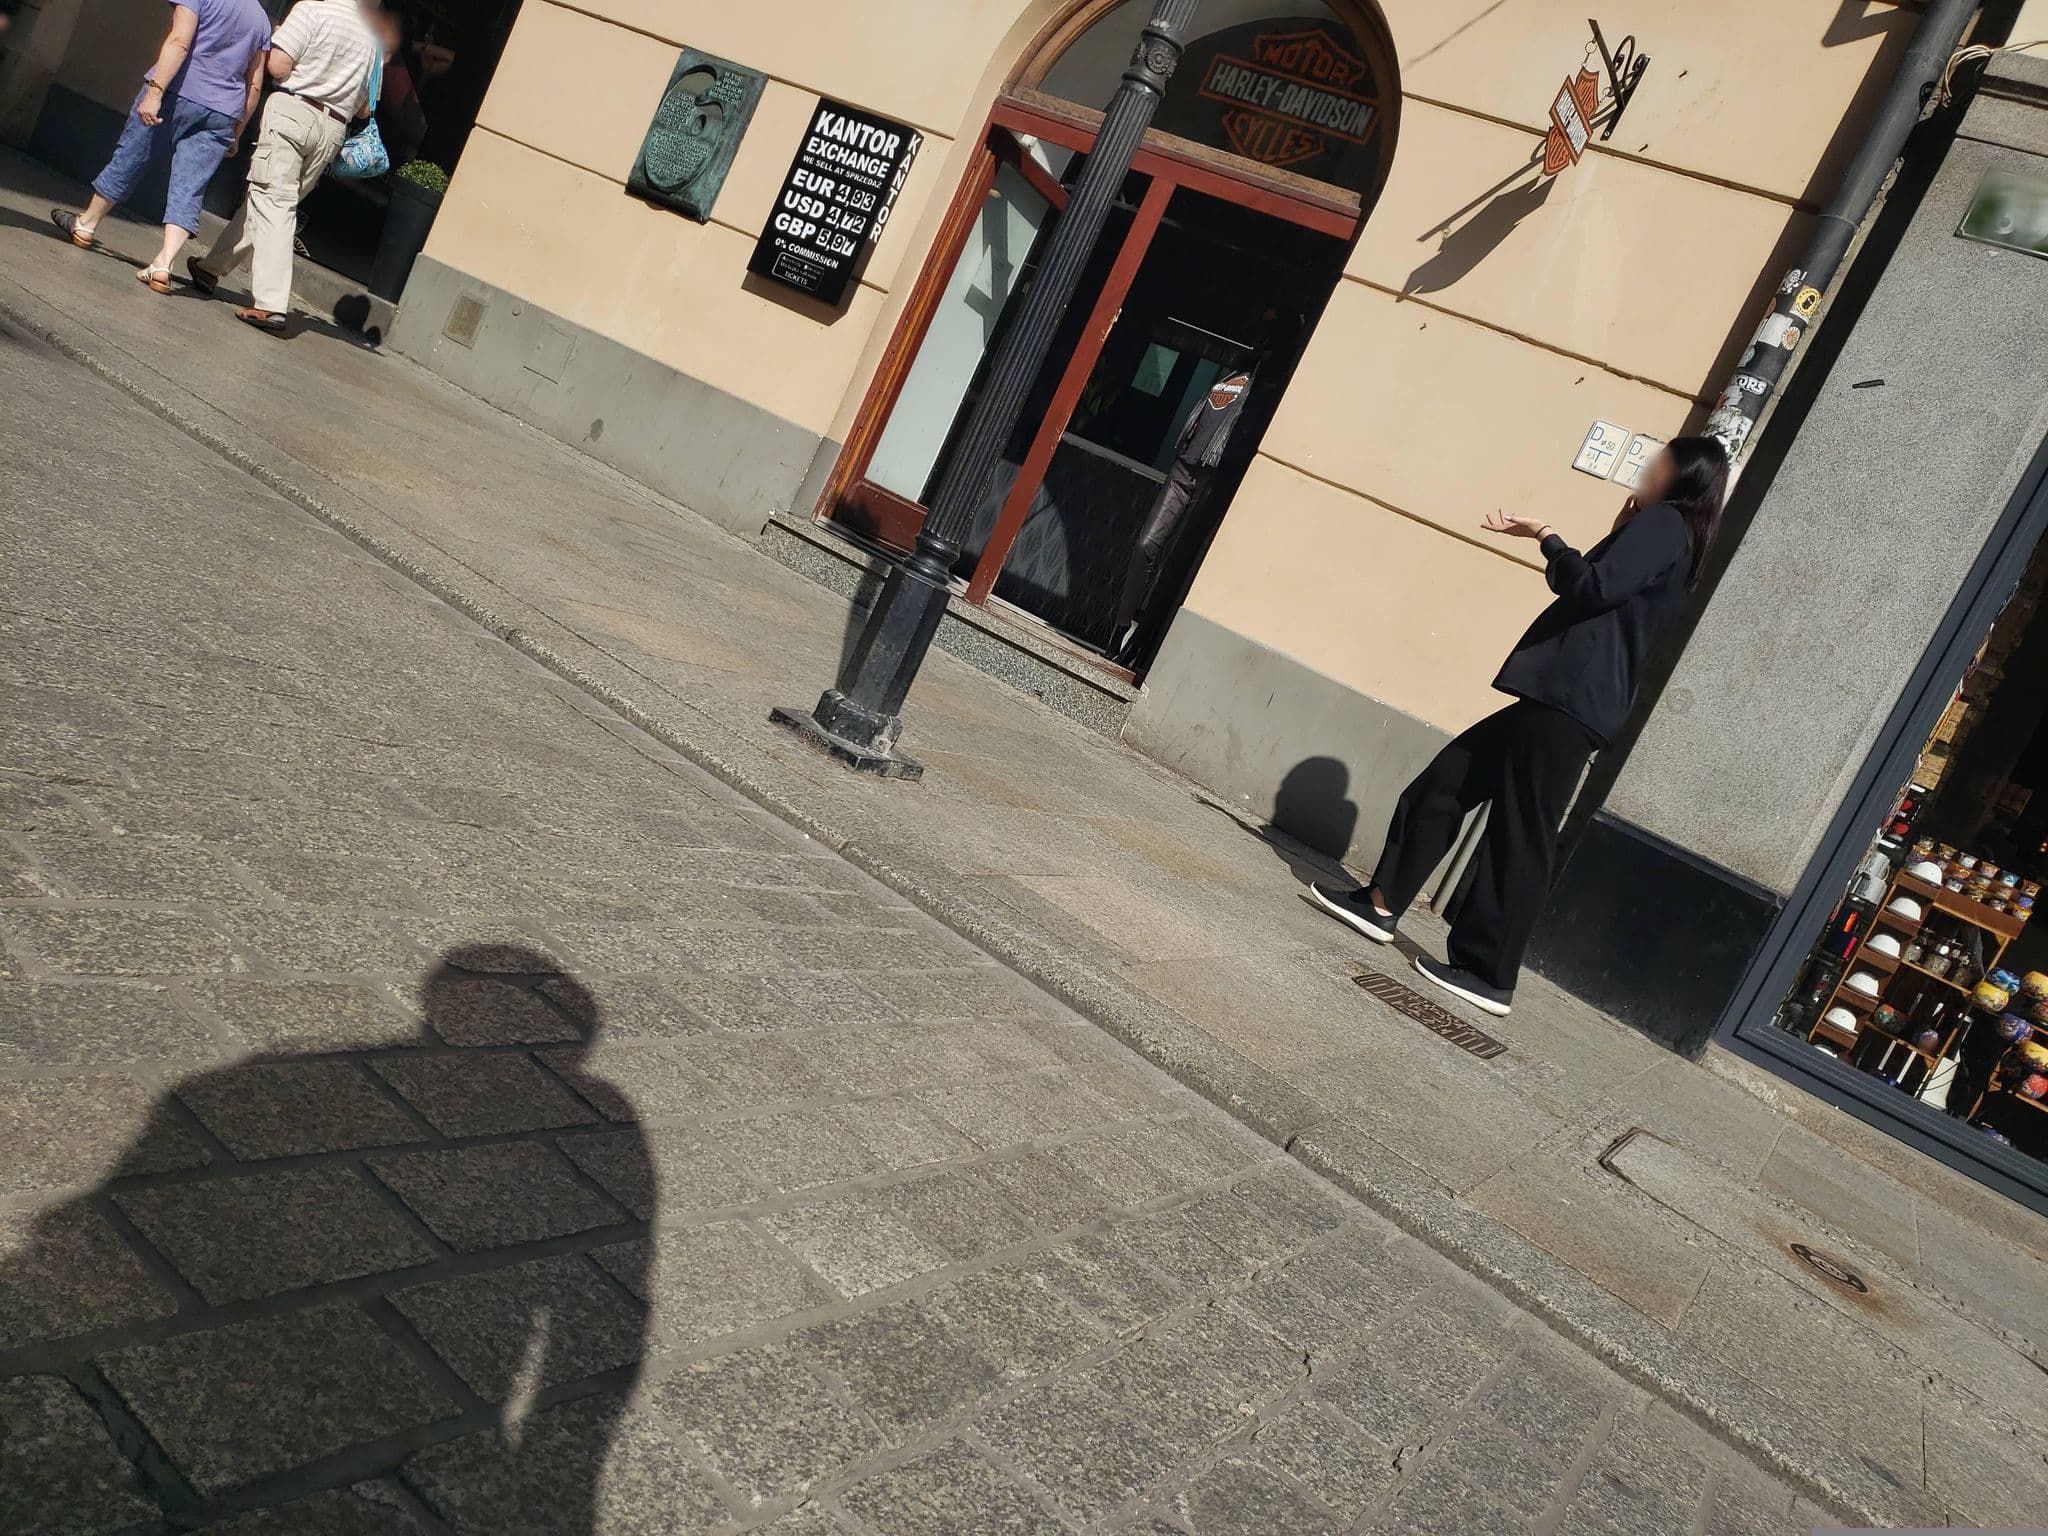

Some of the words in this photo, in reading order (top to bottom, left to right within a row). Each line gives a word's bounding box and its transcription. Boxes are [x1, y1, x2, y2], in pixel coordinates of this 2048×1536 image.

[1263, 38, 1350, 85] MOTOR
[1209, 62, 1373, 137] HARLEY-DAVIDSON
[814, 110, 900, 159] KANTOR
[1233, 112, 1312, 162] CYCLES
[803, 154, 815, 165] WE
[815, 159, 833, 172] SELL
[834, 166, 846, 175] AT
[806, 136, 890, 179] EXCHANGE
[792, 168, 835, 198] EUR
[835, 184, 876, 212] 4,93
[868, 134, 921, 243] KANTOR
[784, 190, 825, 218] USD
[825, 206, 867, 234] 4,72
[775, 213, 817, 239] GBP
[816, 228, 857, 257] 5,97
[788, 243, 839, 269] COMMISSION
[1591, 426, 1604, 441] D
[1628, 440, 1643, 456] D
